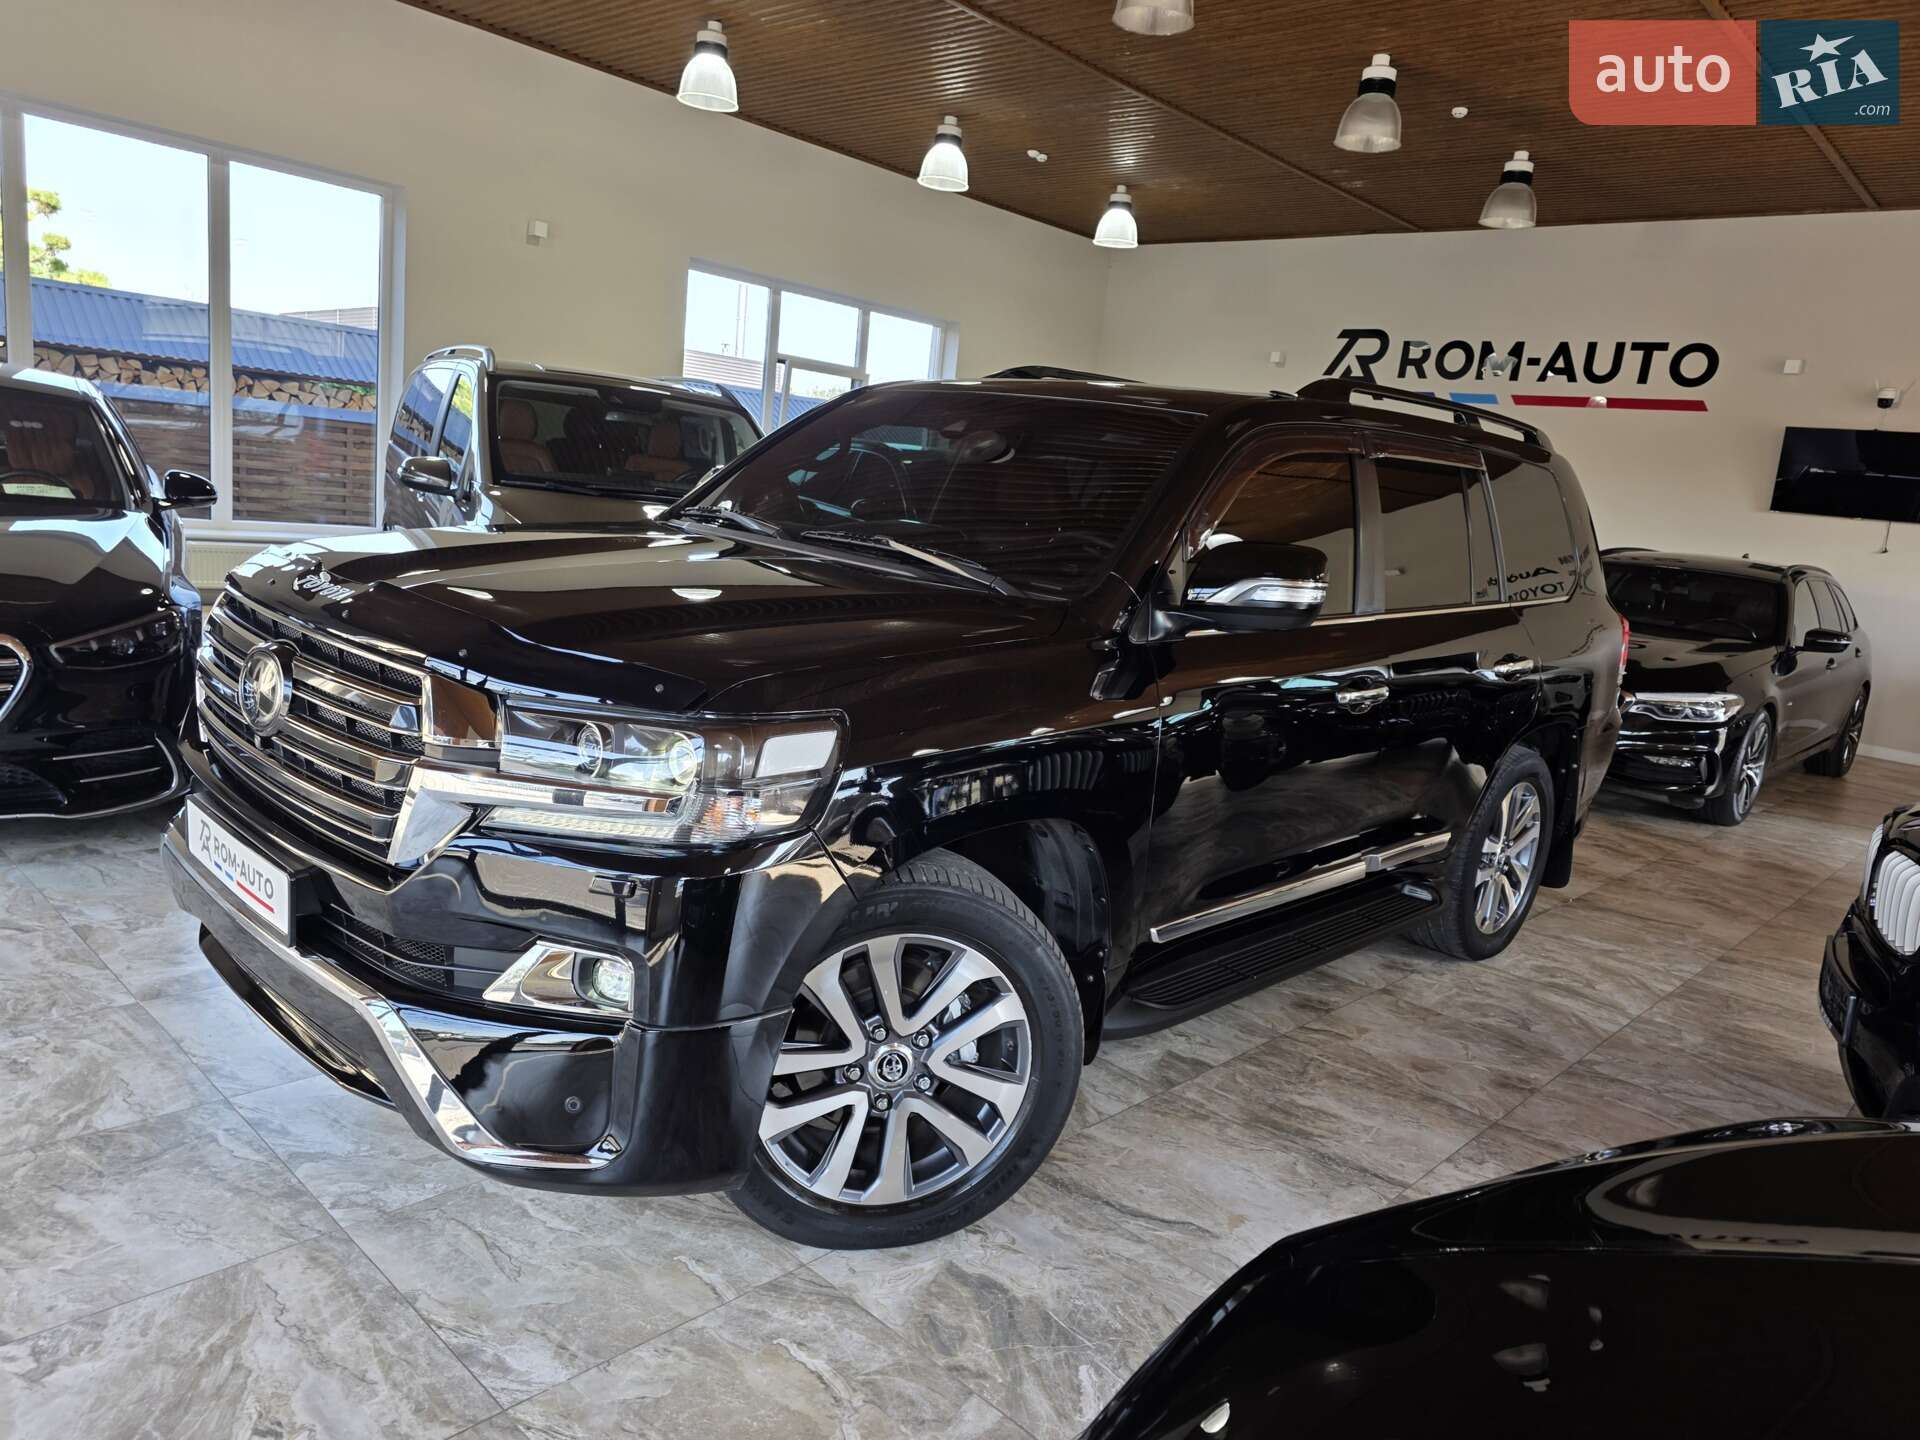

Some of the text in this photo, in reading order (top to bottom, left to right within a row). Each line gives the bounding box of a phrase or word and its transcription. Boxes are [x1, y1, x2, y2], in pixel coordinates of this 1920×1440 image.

[1397, 340, 1719, 388] ROM-AUTO
[292, 575, 356, 601] TOYOTA
[214, 837, 274, 900] ROM-AUTO
